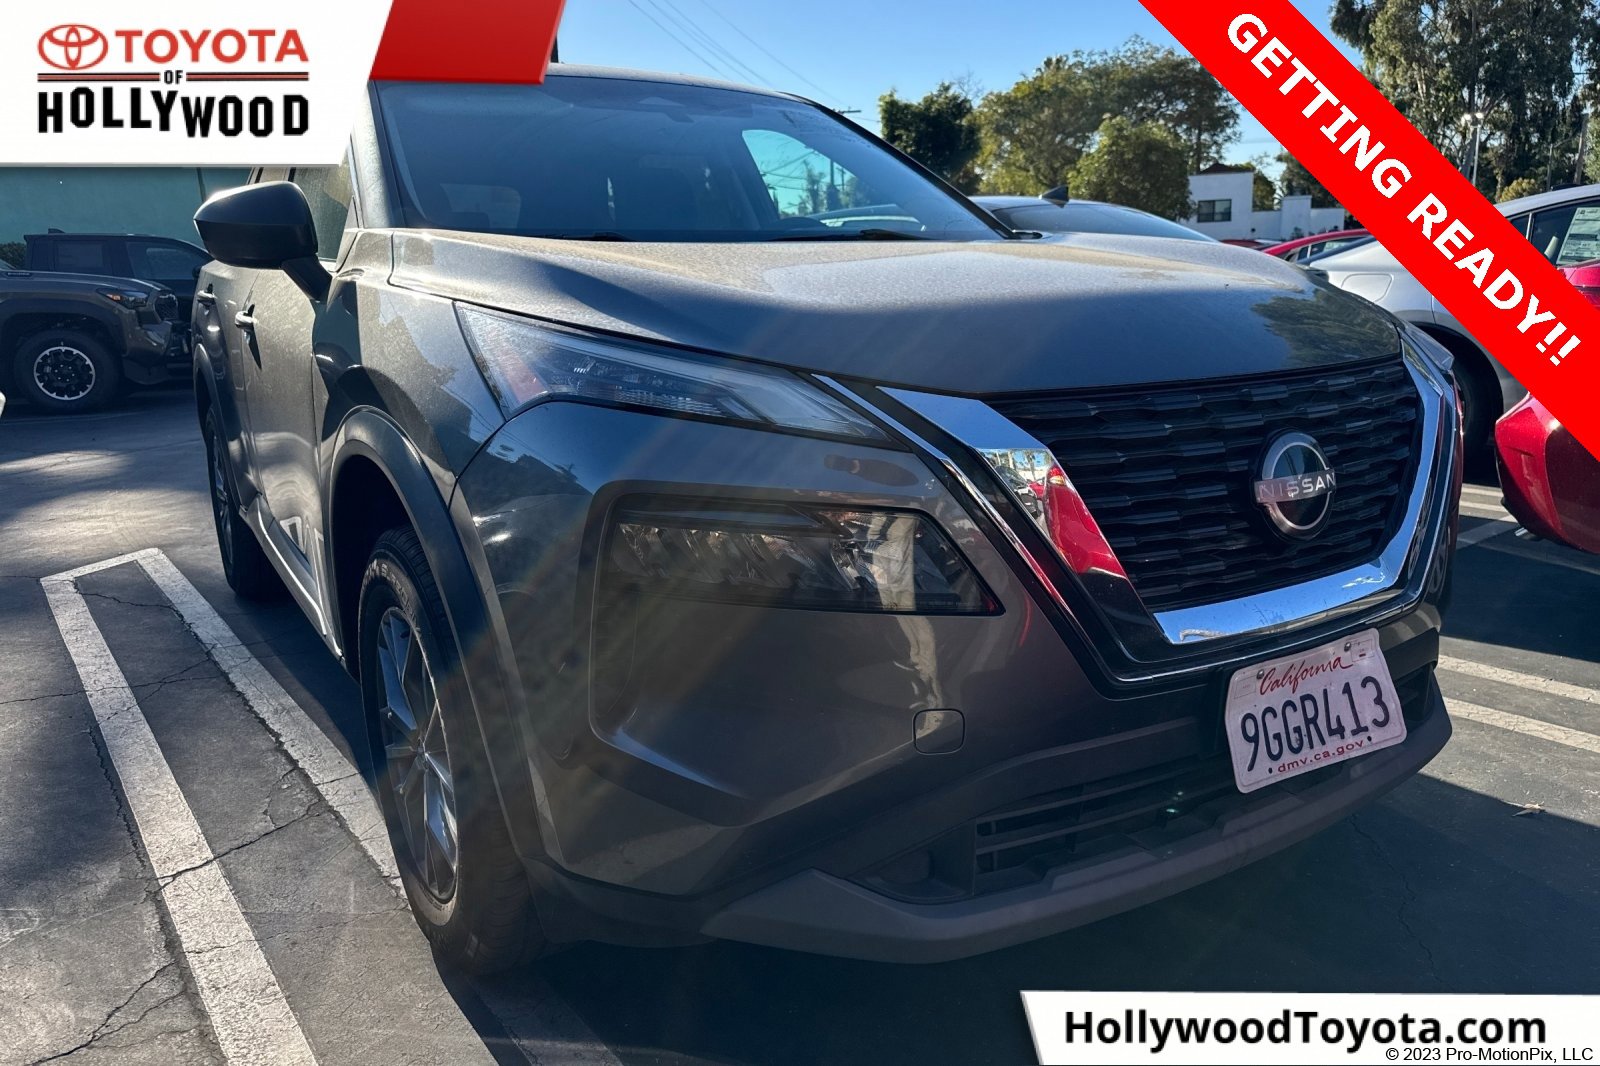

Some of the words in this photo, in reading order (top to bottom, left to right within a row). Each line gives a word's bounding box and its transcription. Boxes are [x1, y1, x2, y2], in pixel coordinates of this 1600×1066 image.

[1258, 472, 1336, 500] NISSAN
[1259, 652, 1354, 696] California
[1240, 675, 1391, 772] 9GGR413
[1277, 738, 1365, 774] dmv.ca.gov
